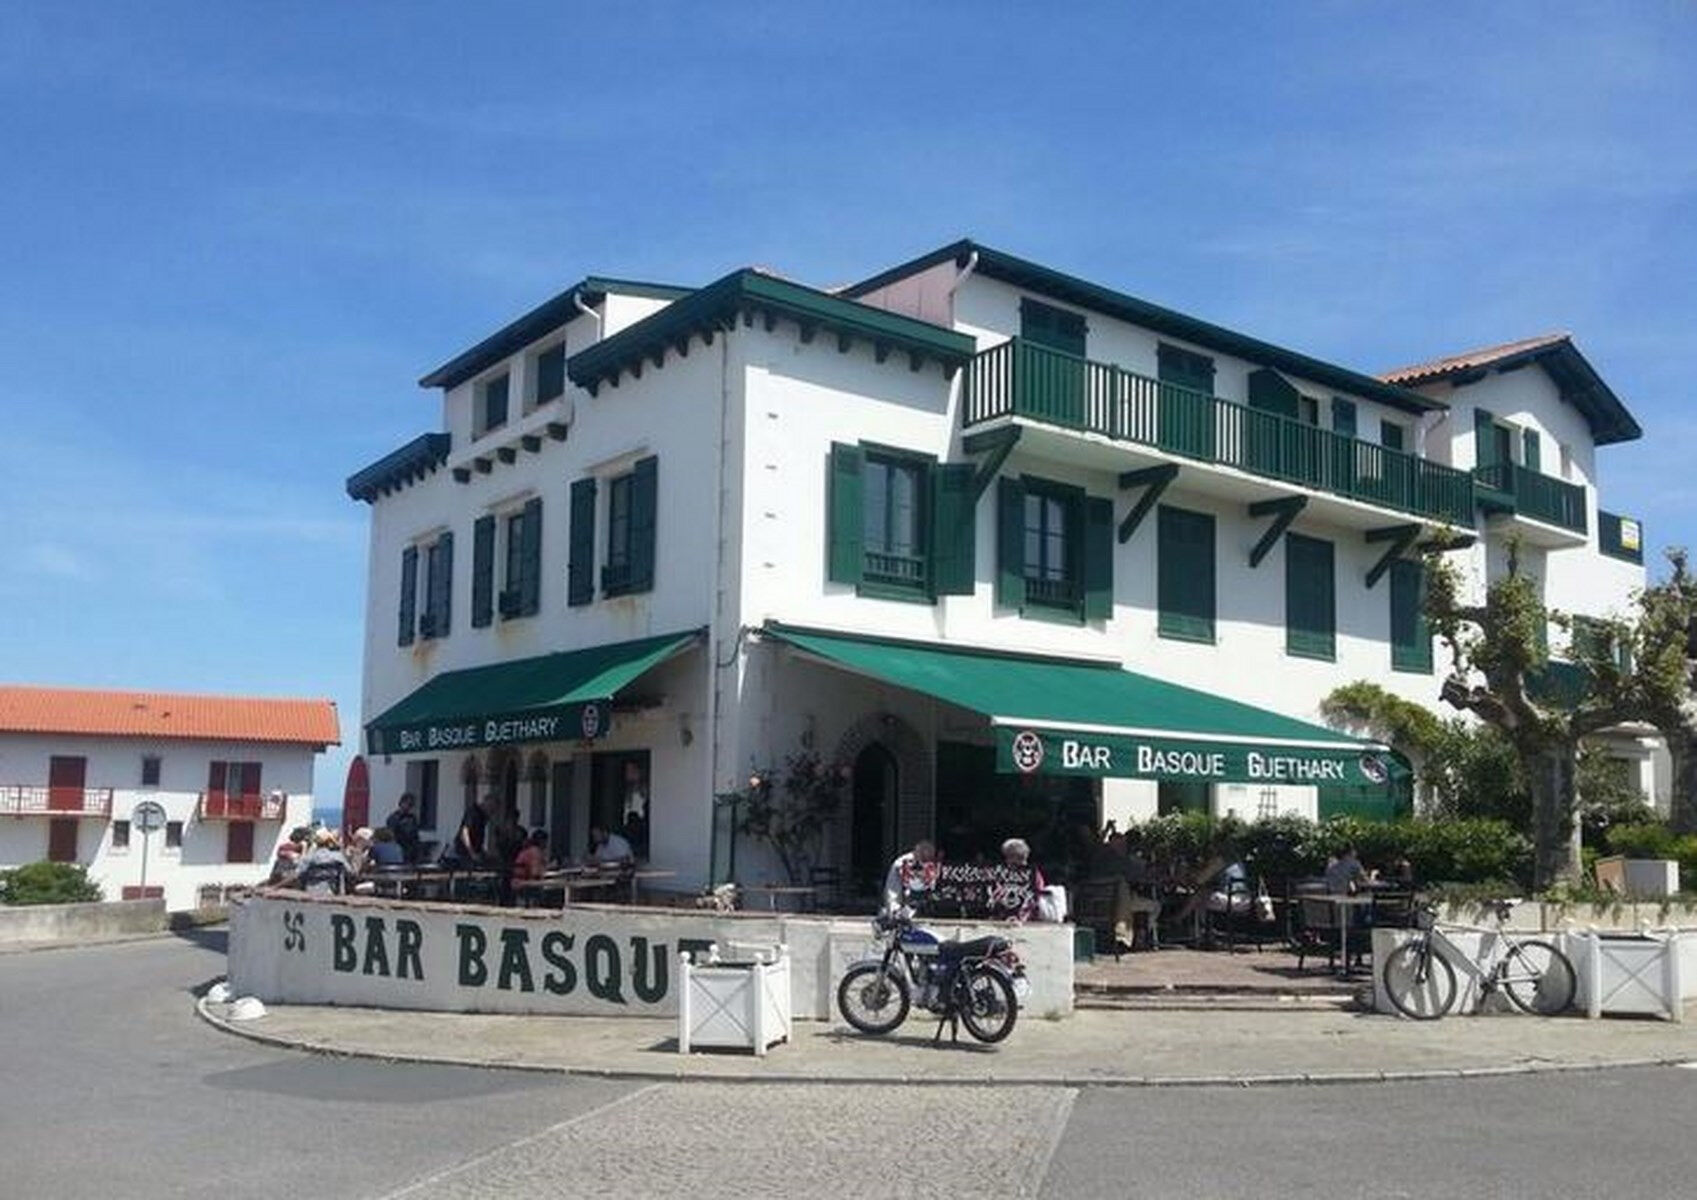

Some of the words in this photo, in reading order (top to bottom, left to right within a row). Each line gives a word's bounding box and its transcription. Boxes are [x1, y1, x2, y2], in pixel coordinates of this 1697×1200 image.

[401, 730, 421, 748] BAR
[429, 726, 476, 746] BASQUE
[485, 718, 558, 741] GUETHARY
[1063, 741, 1111, 768] BAR
[1138, 746, 1225, 775] BASQUE
[1248, 752, 1344, 779] GUETHARY
[331, 914, 423, 980] BAR
[455, 924, 715, 1005] BASQU
